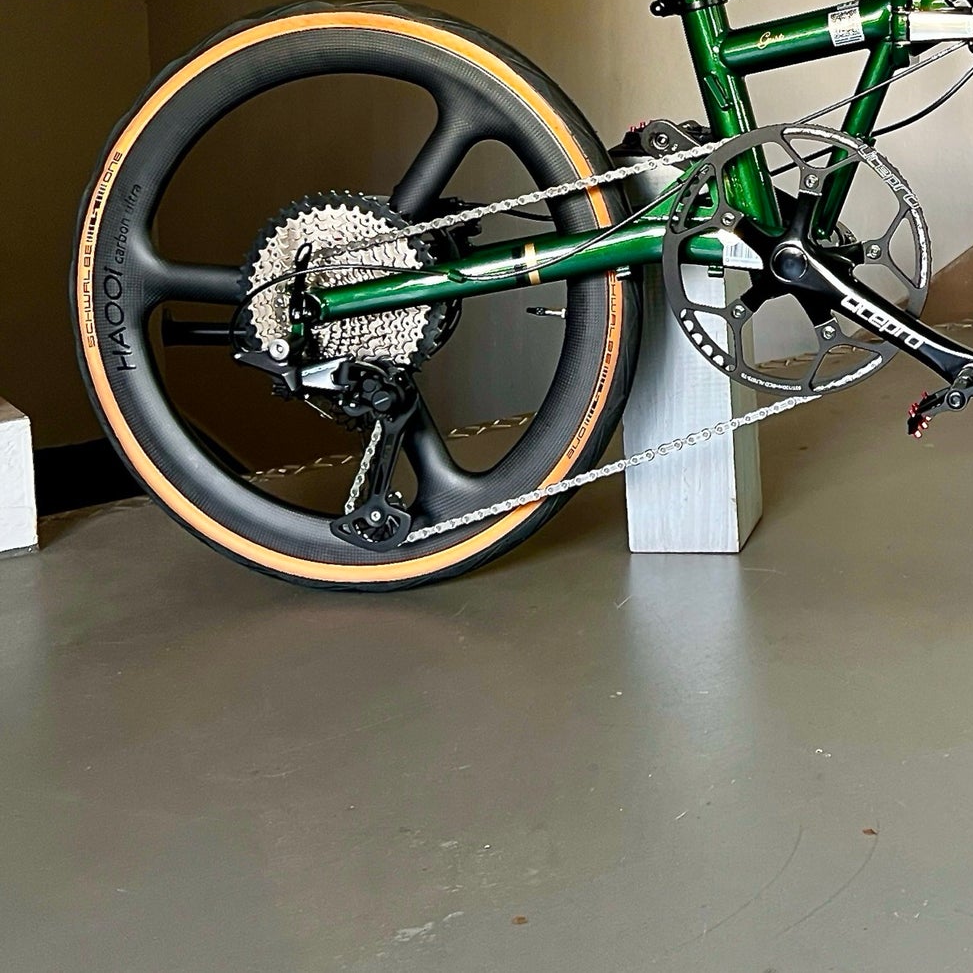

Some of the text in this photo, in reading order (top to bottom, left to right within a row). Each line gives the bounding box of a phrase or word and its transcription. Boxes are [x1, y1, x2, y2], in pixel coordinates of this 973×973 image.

[114, 217, 130, 264] carbon
[124, 183, 142, 215] ultra
[82, 244, 96, 348] SCHWALBE
